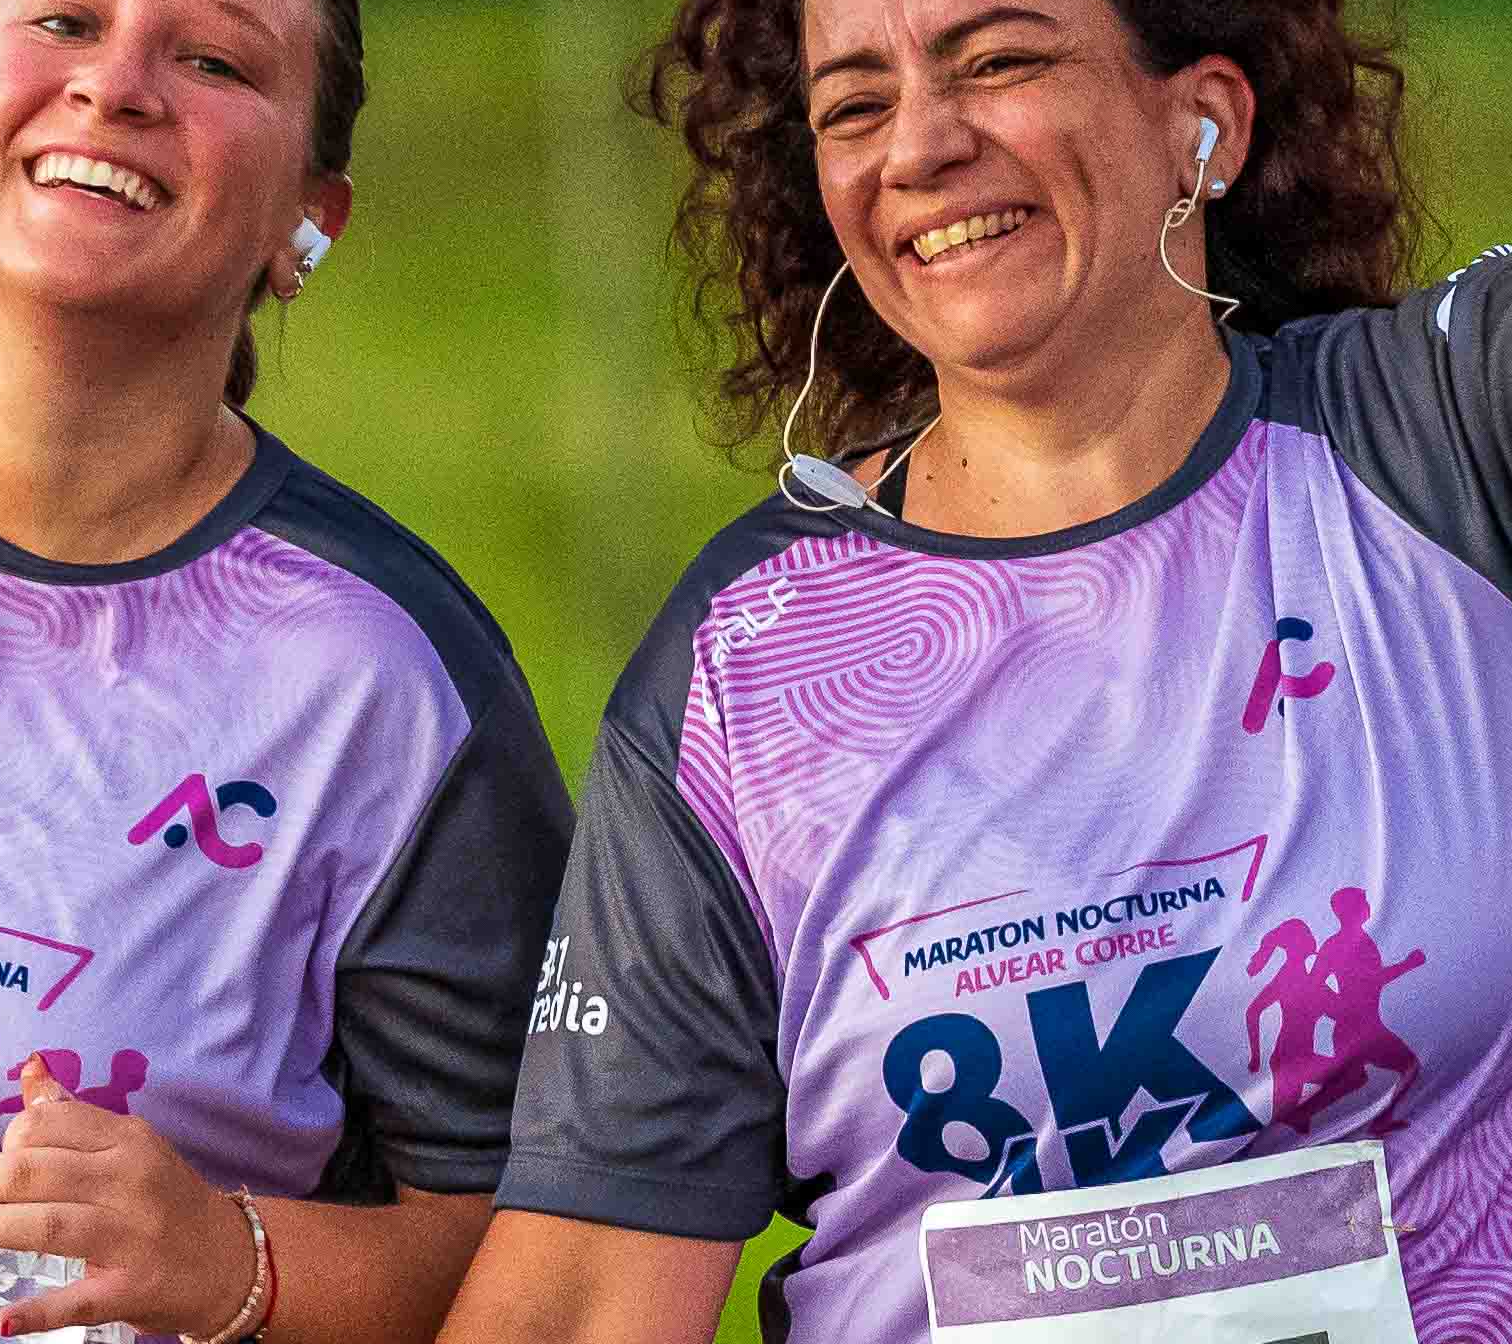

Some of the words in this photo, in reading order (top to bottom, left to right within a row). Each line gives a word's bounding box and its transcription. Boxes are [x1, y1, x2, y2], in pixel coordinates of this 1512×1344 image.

[127, 773, 277, 869] AC
[903, 916, 1045, 977] MARATON
[1056, 876, 1226, 937] NOCTURNA
[954, 947, 1067, 997] ALVEAR
[1074, 922, 1176, 968] CORRE
[883, 945, 1265, 1184] 8K
[1019, 1208, 1169, 1253] Maratón
[1025, 1223, 1280, 1293] NOCTURNA
